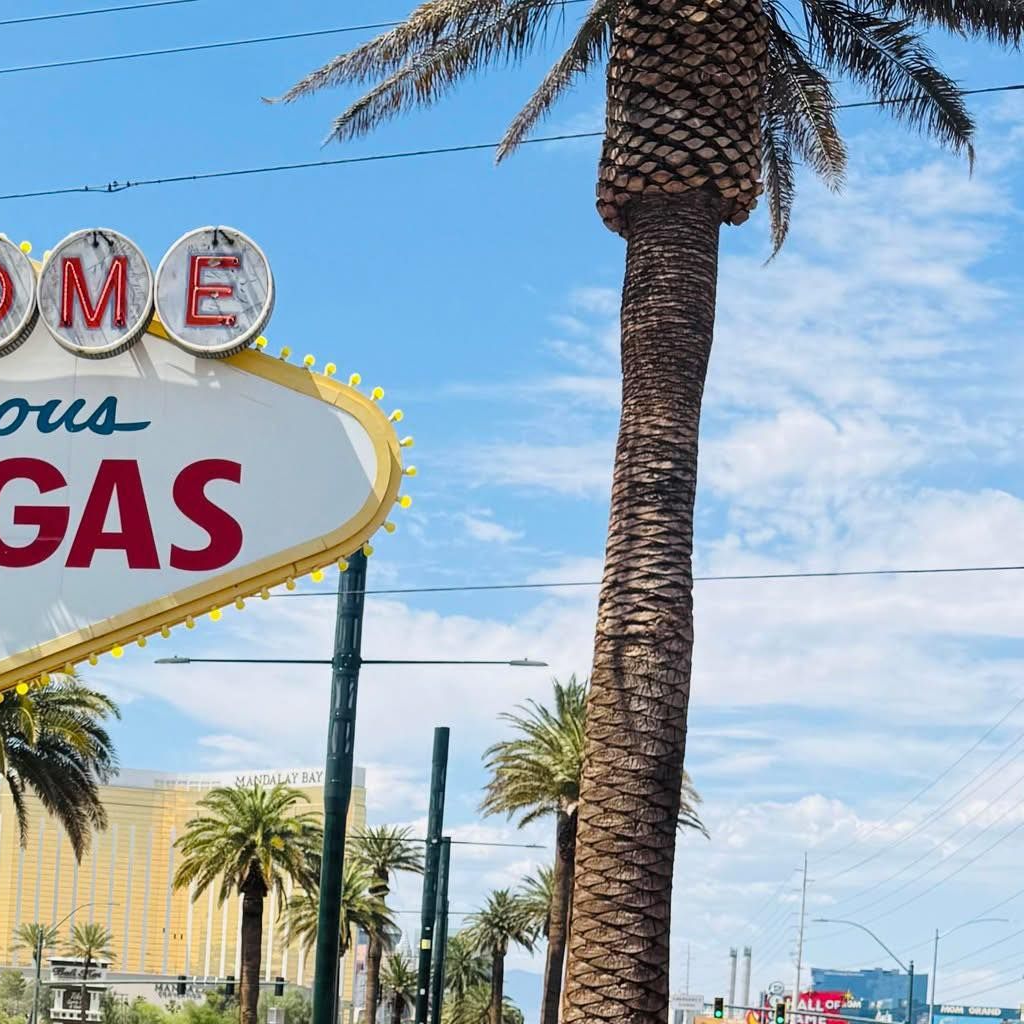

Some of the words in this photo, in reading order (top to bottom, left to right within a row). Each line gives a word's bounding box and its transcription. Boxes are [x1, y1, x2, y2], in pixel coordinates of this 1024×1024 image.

[234, 772, 298, 788] MANDALAY
[301, 770, 324, 784] BAY
[825, 999, 841, 1010] OF
[968, 1006, 1002, 1017] GRAND
